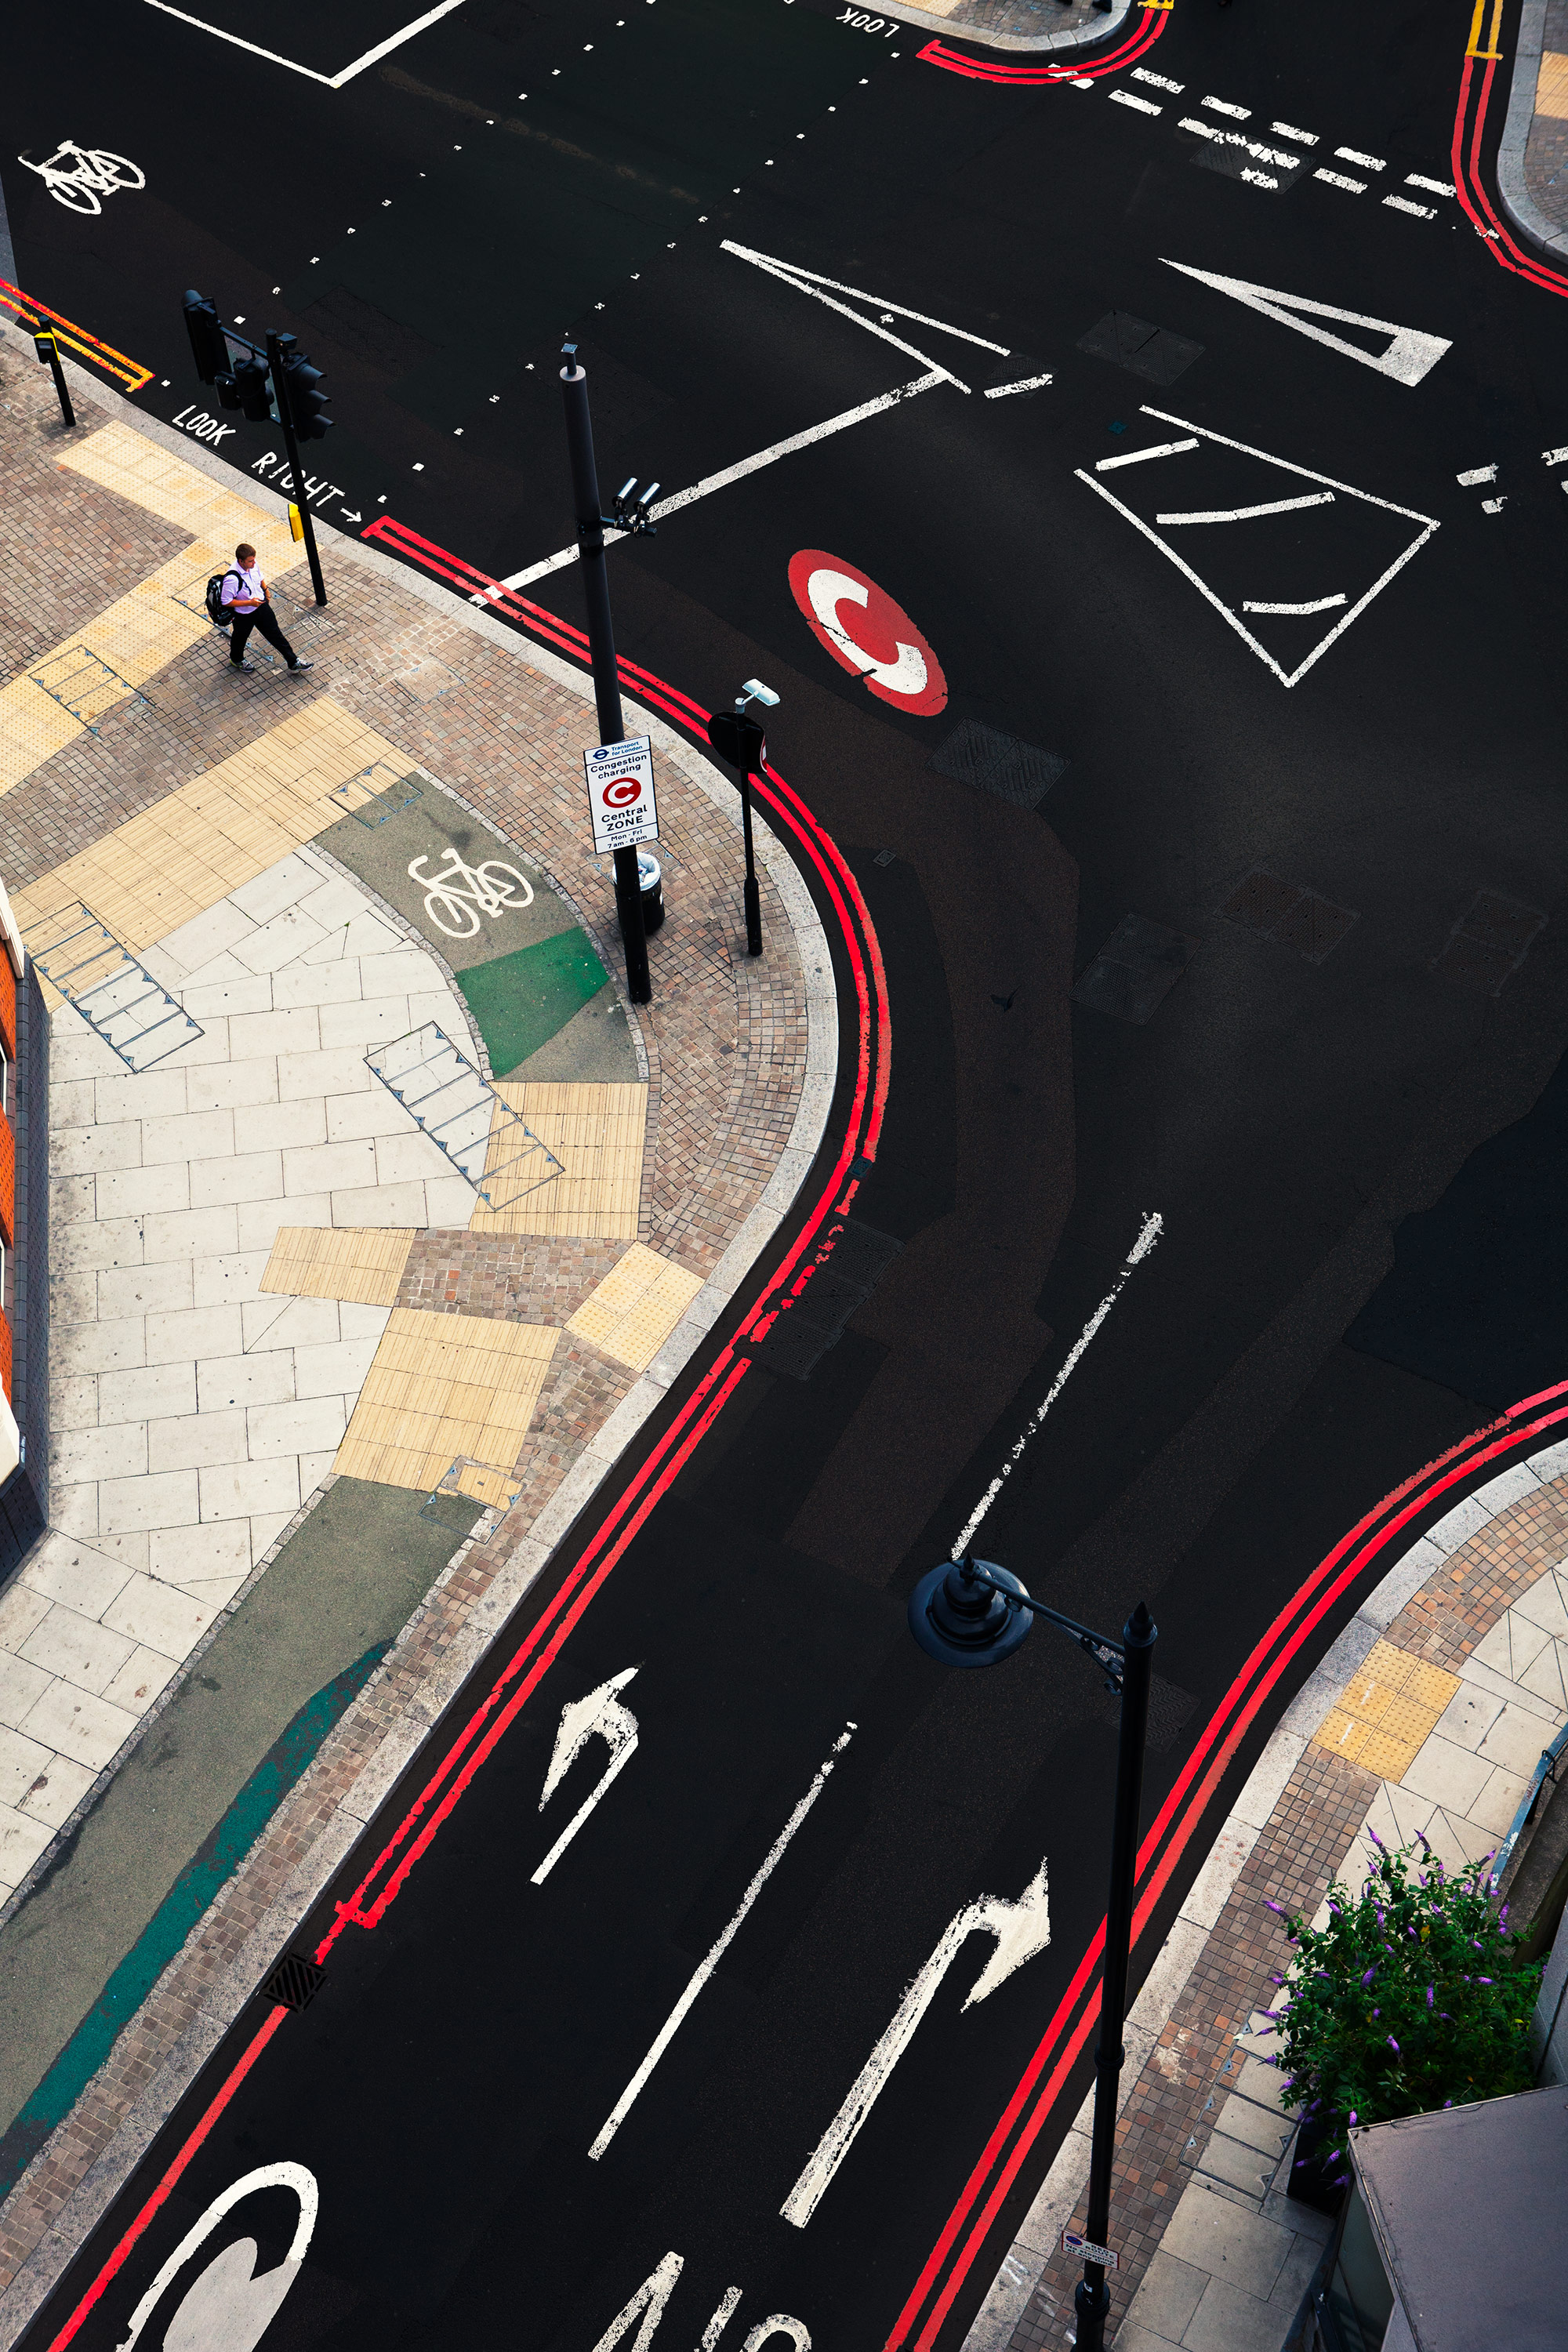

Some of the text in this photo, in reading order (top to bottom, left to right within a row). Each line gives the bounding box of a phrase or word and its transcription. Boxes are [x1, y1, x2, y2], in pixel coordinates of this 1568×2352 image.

[836, 7, 900, 38] LOOK
[172, 405, 236, 446] LOOK
[612, 741, 640, 751] Transport
[621, 745, 643, 754] London
[590, 754, 648, 773] Congestion
[597, 764, 641, 780] charging
[601, 804, 648, 823] Central
[606, 815, 644, 832] ZONE
[1080, 2249, 1115, 2264] stopping
[1085, 2245, 1115, 2259] ROUTE
[1091, 2244, 1109, 2254] RED
